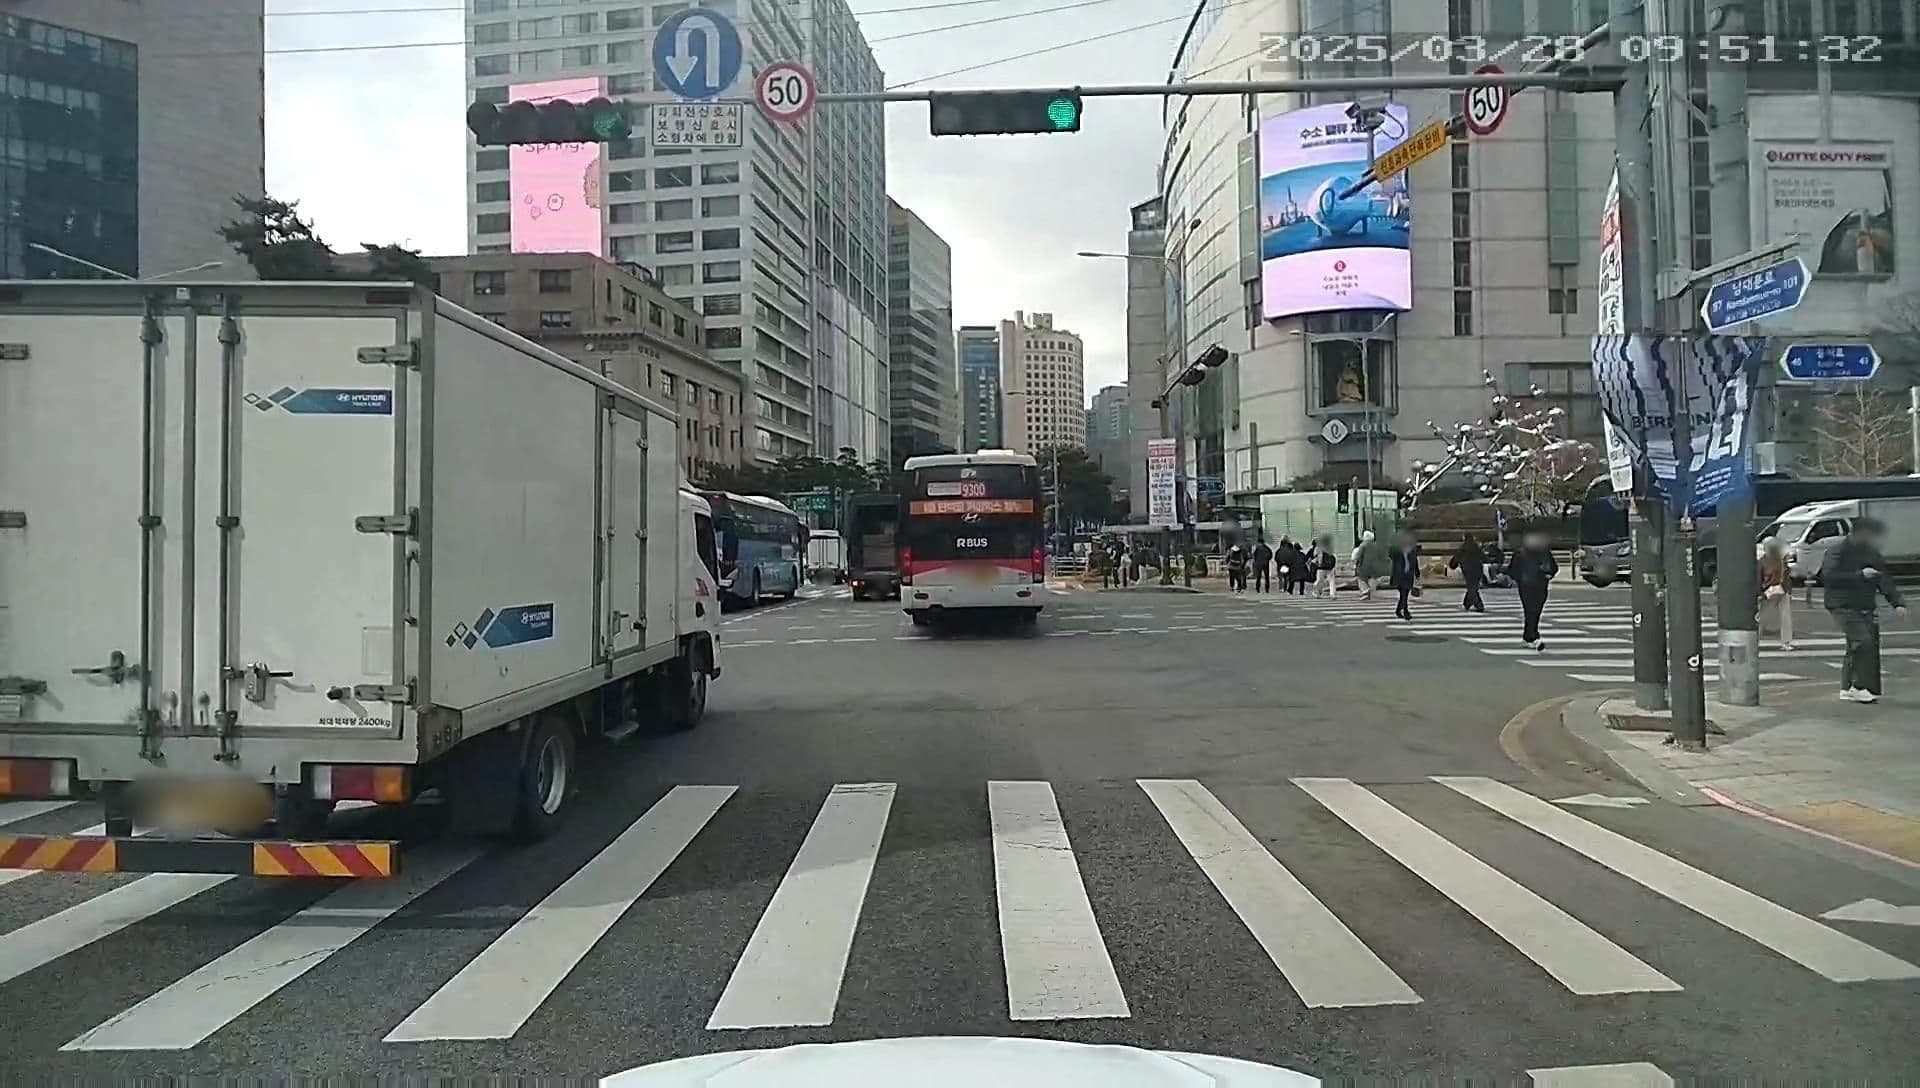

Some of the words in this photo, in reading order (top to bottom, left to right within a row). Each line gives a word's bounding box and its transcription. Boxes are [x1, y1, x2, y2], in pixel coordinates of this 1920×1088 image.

[767, 76, 802, 105] 50
[1471, 84, 1501, 123] 50
[1780, 152, 1817, 161] LOTTE
[1820, 152, 1852, 162] DUTY
[352, 394, 386, 402] HYUNDAI
[962, 483, 985, 496] 9300
